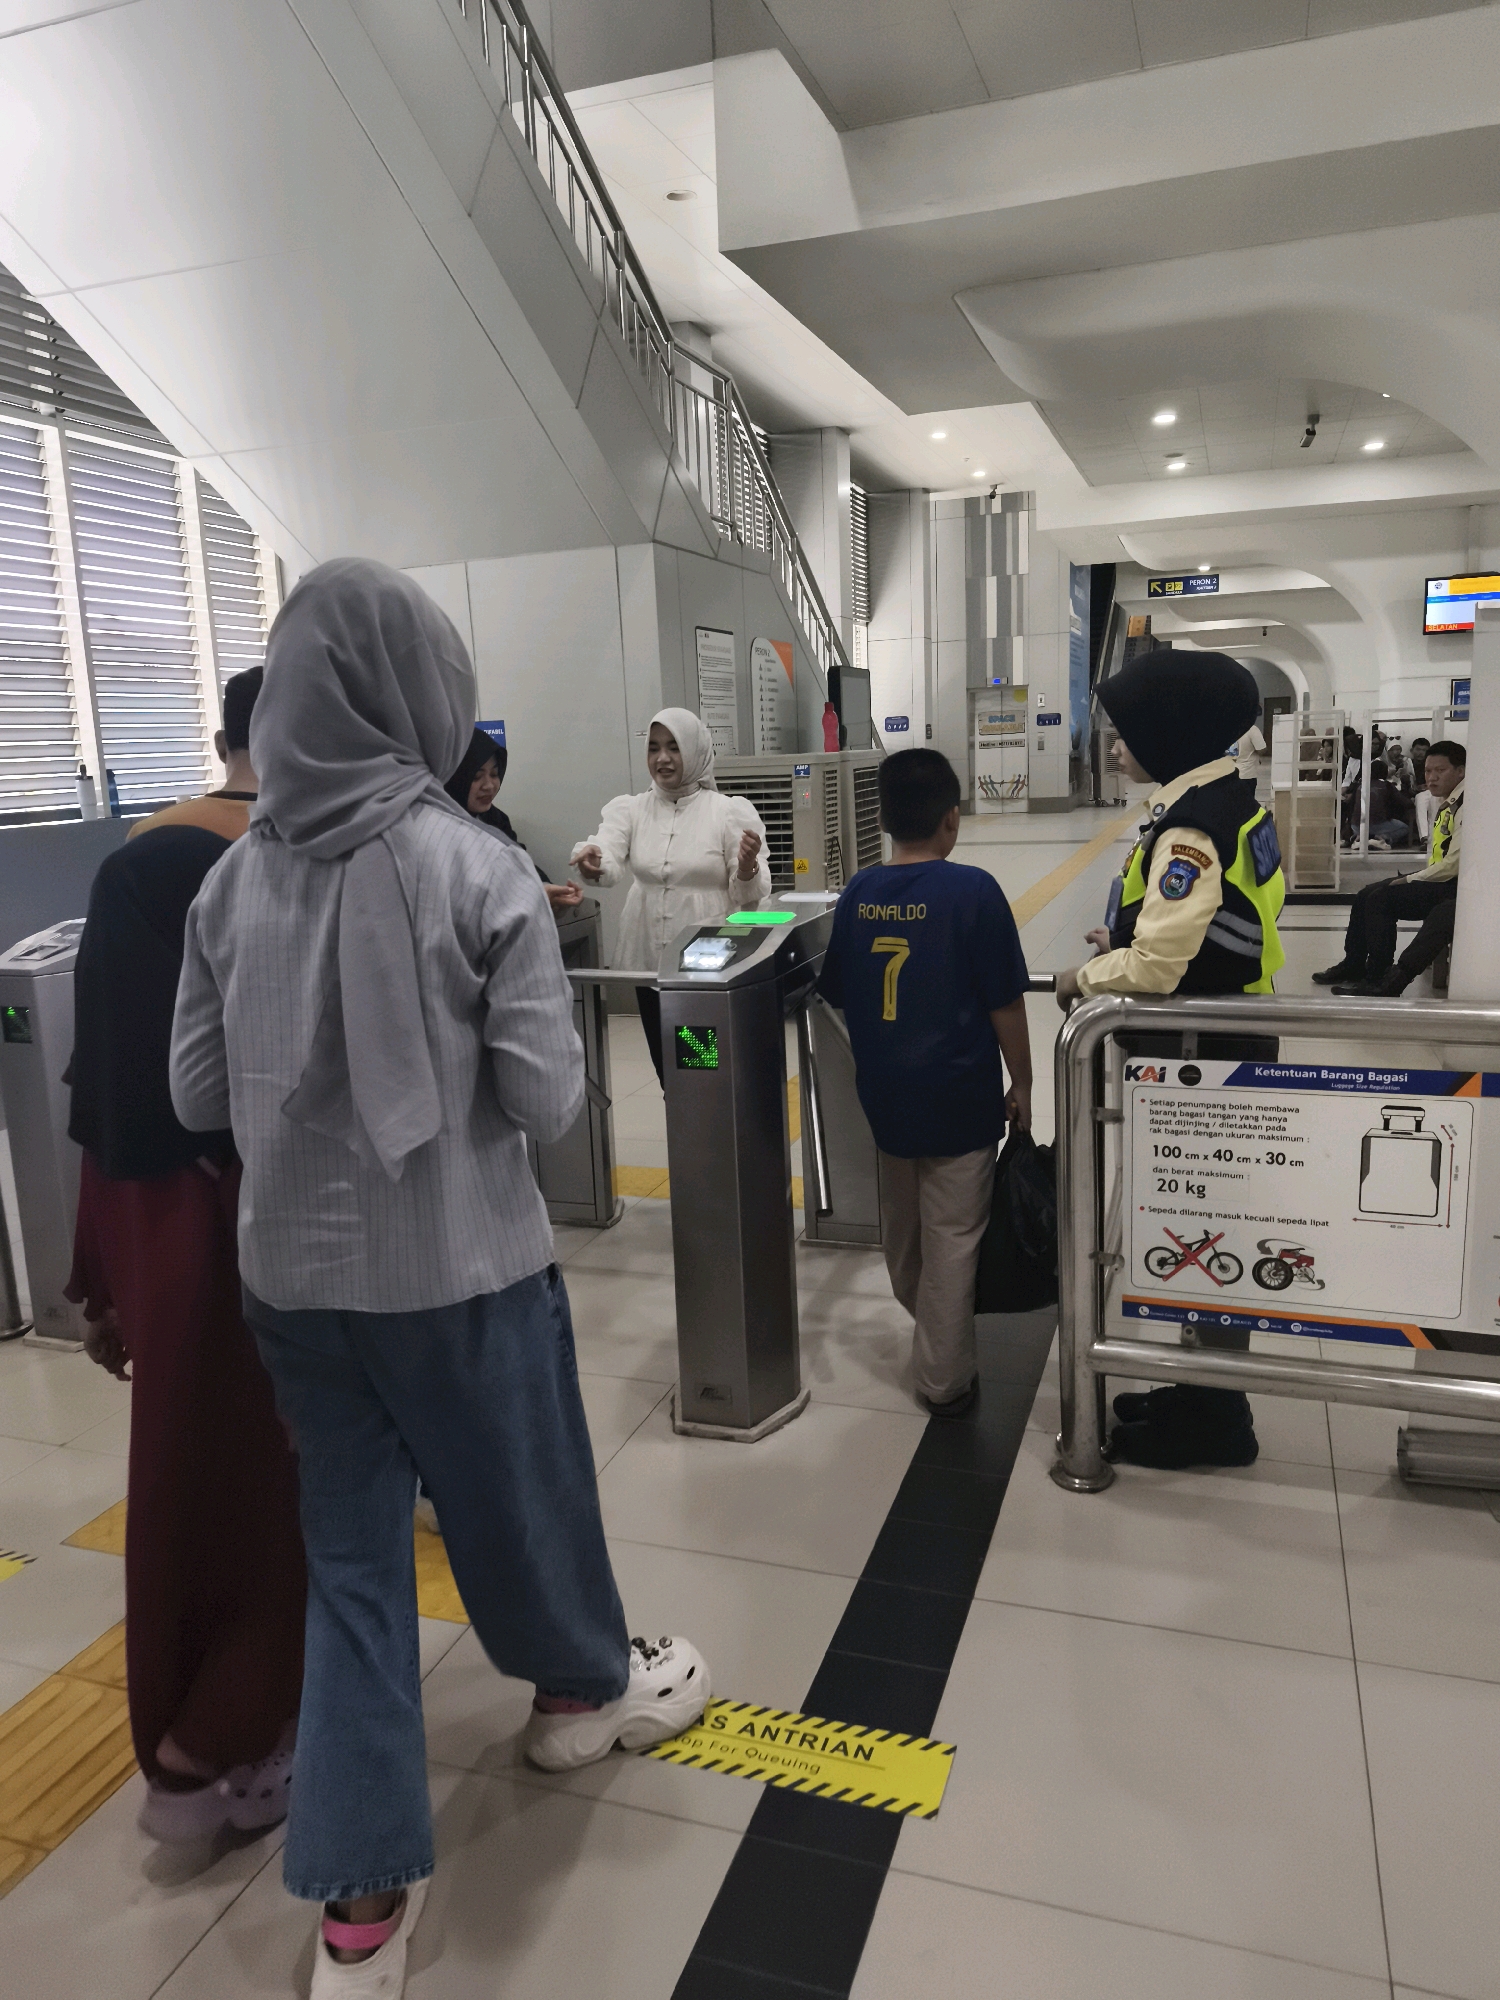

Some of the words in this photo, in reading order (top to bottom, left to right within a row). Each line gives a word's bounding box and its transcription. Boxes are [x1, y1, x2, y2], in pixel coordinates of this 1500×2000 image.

[1174, 846, 1210, 866] PALEMBANG
[858, 903, 927, 920] RONALDO
[871, 936, 910, 1020] 7
[1125, 1065, 1166, 1082] KAI
[1255, 1067, 1317, 1078] Ketentuan
[1321, 1069, 1364, 1083] Barang
[1368, 1071, 1408, 1084] Bagasi
[1149, 1099, 1175, 1108] Setiap
[1177, 1101, 1227, 1111] penumpang
[1228, 1102, 1253, 1111] boleh
[1255, 1104, 1300, 1114] membawa
[1149, 1108, 1177, 1118] barang
[1180, 1110, 1205, 1119] bagasi
[1208, 1112, 1237, 1121] tangan
[1261, 1115, 1288, 1123] hanya
[1149, 1117, 1172, 1126] dapat
[1175, 1118, 1210, 1129] dijinjing
[1219, 1122, 1263, 1131] diletakkan
[1265, 1124, 1287, 1133] pada
[1164, 1127, 1190, 1137] bagasi
[1193, 1129, 1224, 1138] dengan
[1225, 1131, 1255, 1139] ukuran
[1258, 1133, 1304, 1143] maksimum
[1153, 1144, 1182, 1159] 100
[1185, 1152, 1200, 1160] cm
[1212, 1149, 1234, 1162] 40
[1236, 1156, 1251, 1164] cm
[1265, 1151, 1286, 1166] 30
[1152, 1166, 1169, 1174] dan
[1171, 1168, 1194, 1176] berat
[1197, 1170, 1244, 1180] maksimum
[1156, 1178, 1179, 1193] 20
[1185, 1180, 1206, 1199] kg
[1148, 1205, 1177, 1215] Sepeda
[1179, 1208, 1213, 1219] dilarang
[1215, 1212, 1242, 1220] masuk
[1244, 1214, 1275, 1223] kecuali
[1277, 1217, 1307, 1227] sepeda
[1310, 1219, 1330, 1227] lipat
[738, 1723, 875, 1762] ANTRIAN
[709, 1740, 738, 1755] For
[745, 1746, 821, 1775] Queuing
